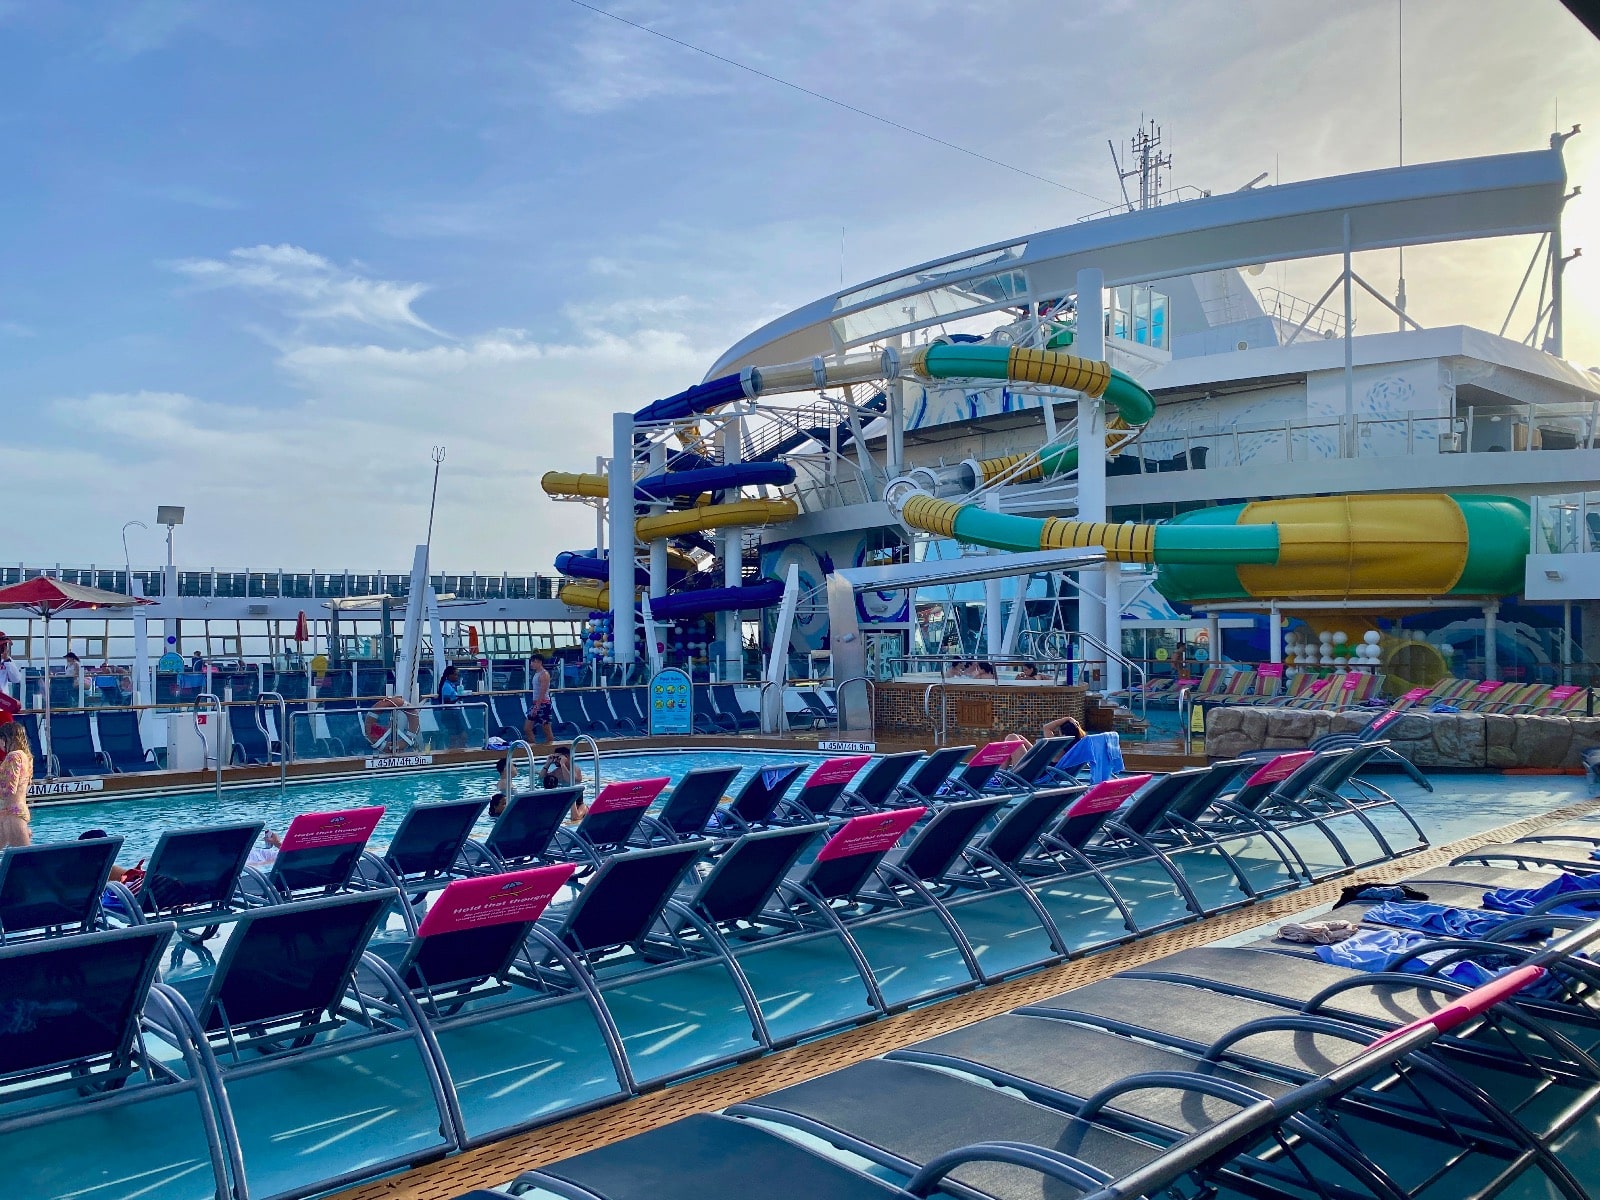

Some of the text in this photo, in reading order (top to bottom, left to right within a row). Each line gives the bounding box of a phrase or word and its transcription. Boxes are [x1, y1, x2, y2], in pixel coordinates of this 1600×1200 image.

[453, 904, 482, 915] Hold
[484, 900, 507, 909] that
[510, 893, 551, 905] thought
